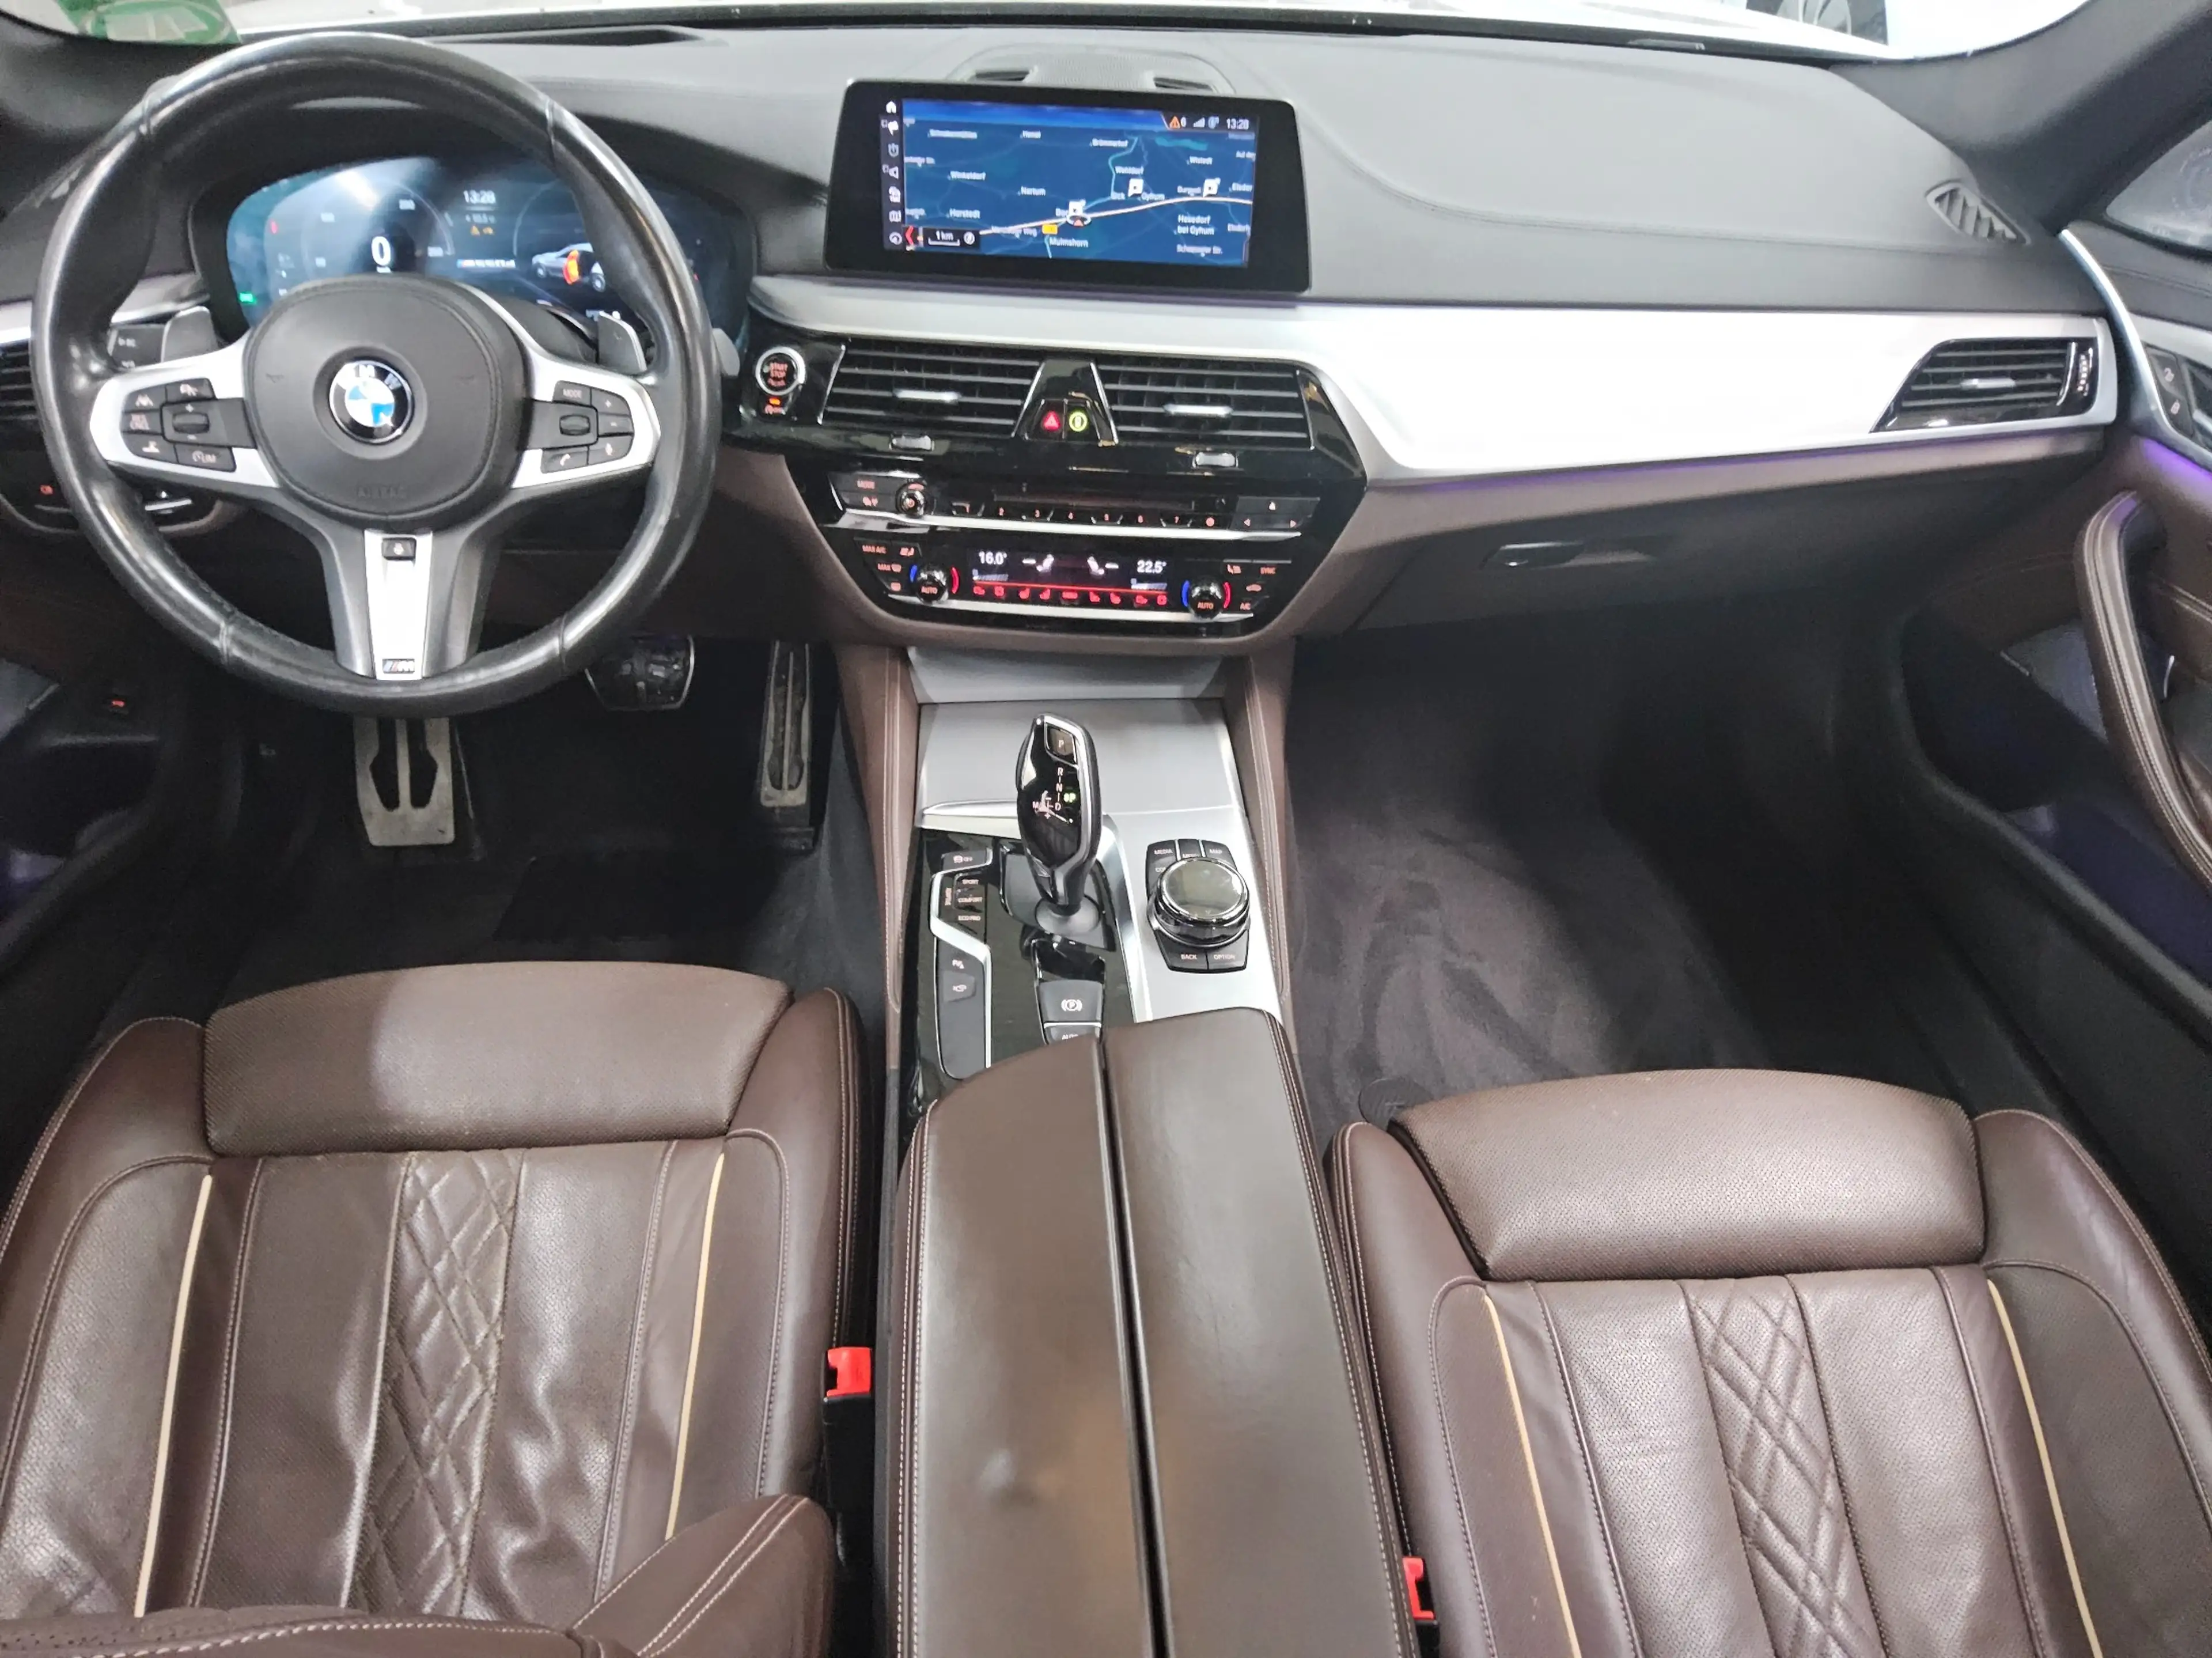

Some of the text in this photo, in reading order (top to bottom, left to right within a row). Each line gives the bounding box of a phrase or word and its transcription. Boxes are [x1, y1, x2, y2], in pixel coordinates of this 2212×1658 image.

[936, 230, 953, 240] 1 km
[372, 236, 391, 266] 0
[563, 389, 582, 399] MODE
[979, 551, 1007, 565] 16.0°
[1137, 559, 1167, 574] 22.5°
[922, 586, 938, 595] AUTO
[1058, 740, 1065, 748] P
[1058, 767, 1064, 776] R
[1056, 783, 1062, 792] N
[1055, 802, 1062, 811] D
